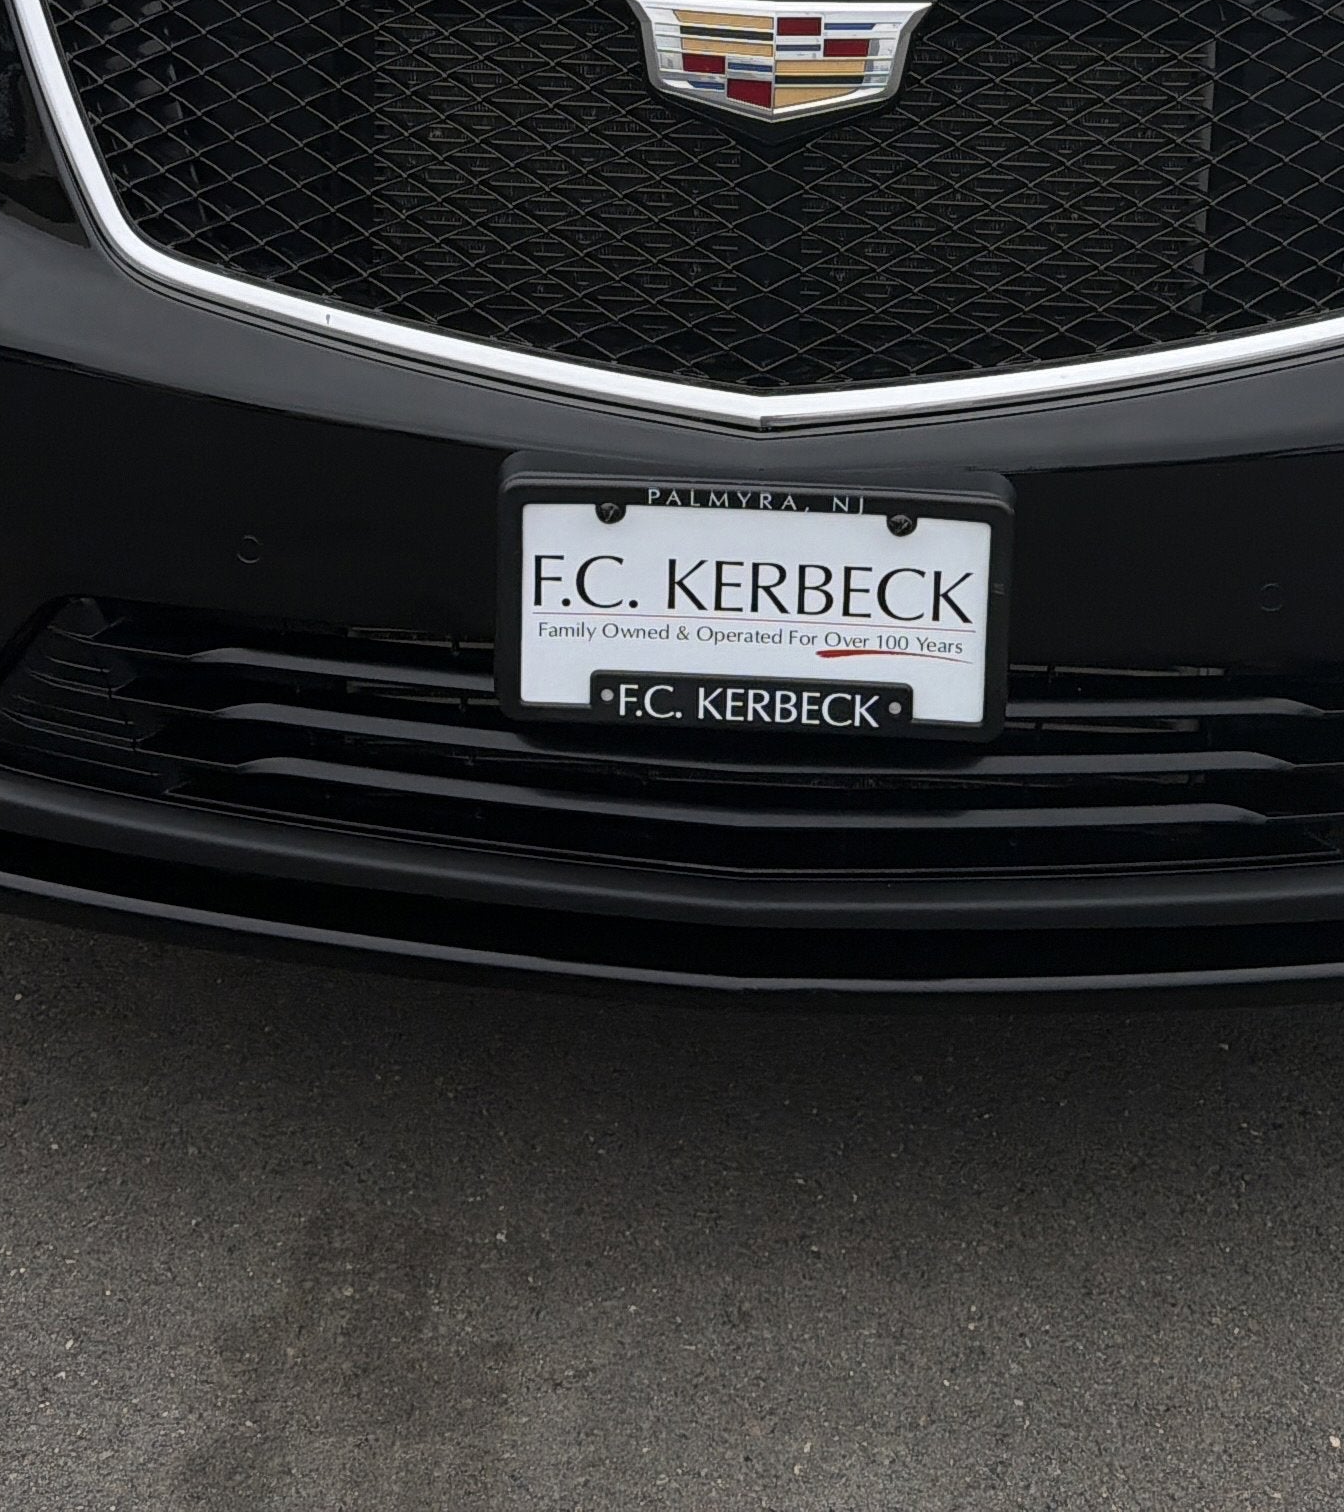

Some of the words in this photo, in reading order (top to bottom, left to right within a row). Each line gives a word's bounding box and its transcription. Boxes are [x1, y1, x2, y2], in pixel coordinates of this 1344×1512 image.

[647, 488, 809, 512] PALMYRA,
[832, 495, 864, 515] NJ
[533, 554, 639, 609] F.C.
[666, 558, 974, 624] KERBECK
[538, 621, 597, 642] Family
[602, 622, 670, 640] Owned
[676, 625, 690, 641] &
[696, 625, 783, 645] Operated
[789, 630, 818, 646] For
[824, 631, 870, 649] Over
[876, 634, 909, 651] 100
[915, 636, 963, 654] Years
[619, 684, 683, 719] F.C.
[698, 687, 880, 728] KERBECK
